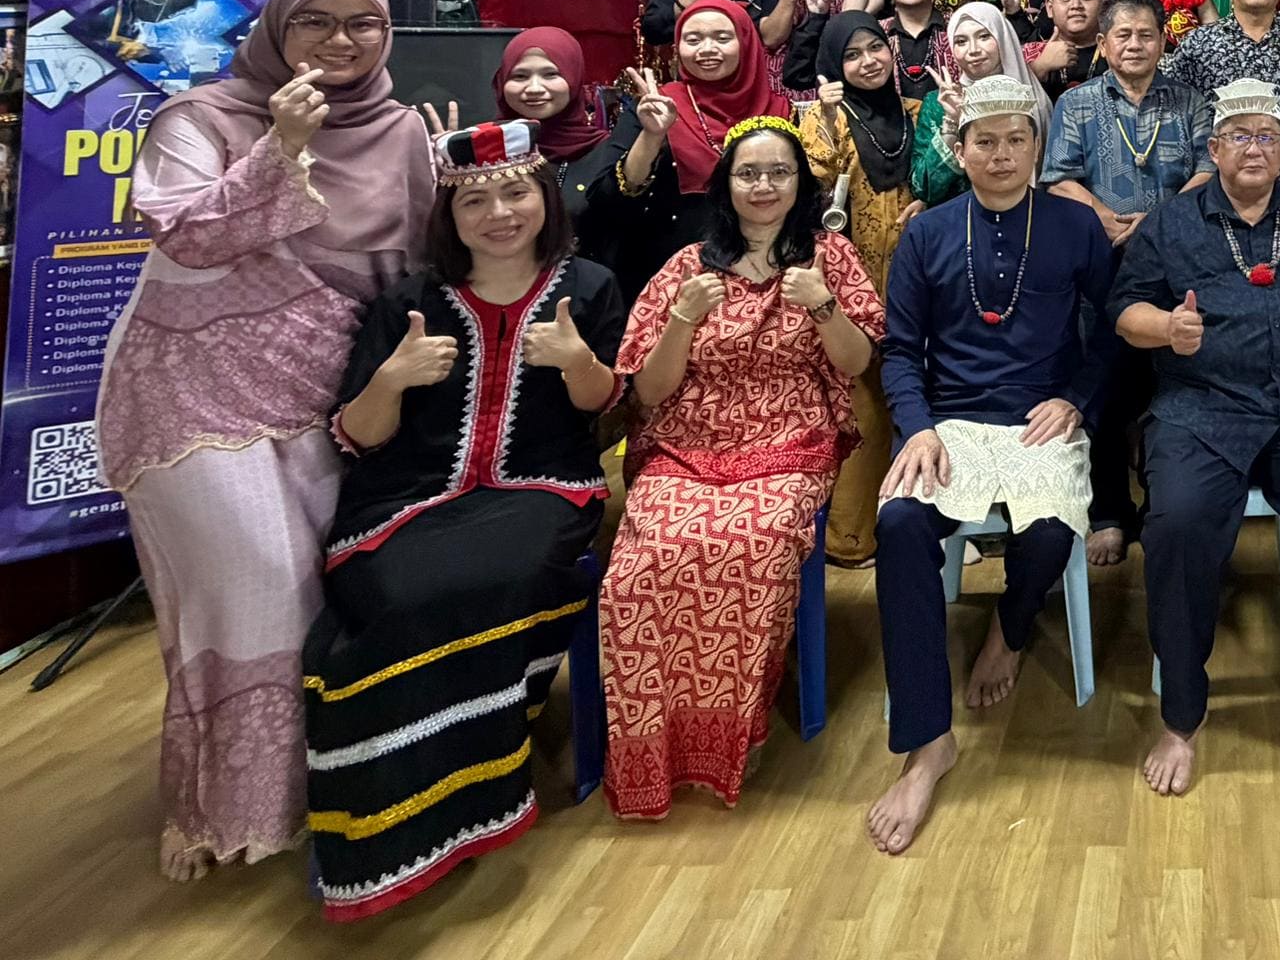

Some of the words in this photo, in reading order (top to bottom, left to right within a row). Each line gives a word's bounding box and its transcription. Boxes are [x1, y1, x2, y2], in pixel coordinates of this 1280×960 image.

[47, 228, 123, 240] PILIHAN
[58, 263, 113, 275] Diploma
[57, 277, 112, 289] Diploma
[56, 291, 111, 303] Diploma
[55, 305, 110, 317] Diploma
[54, 319, 109, 331] Diploma
[54, 334, 108, 346] Diploma
